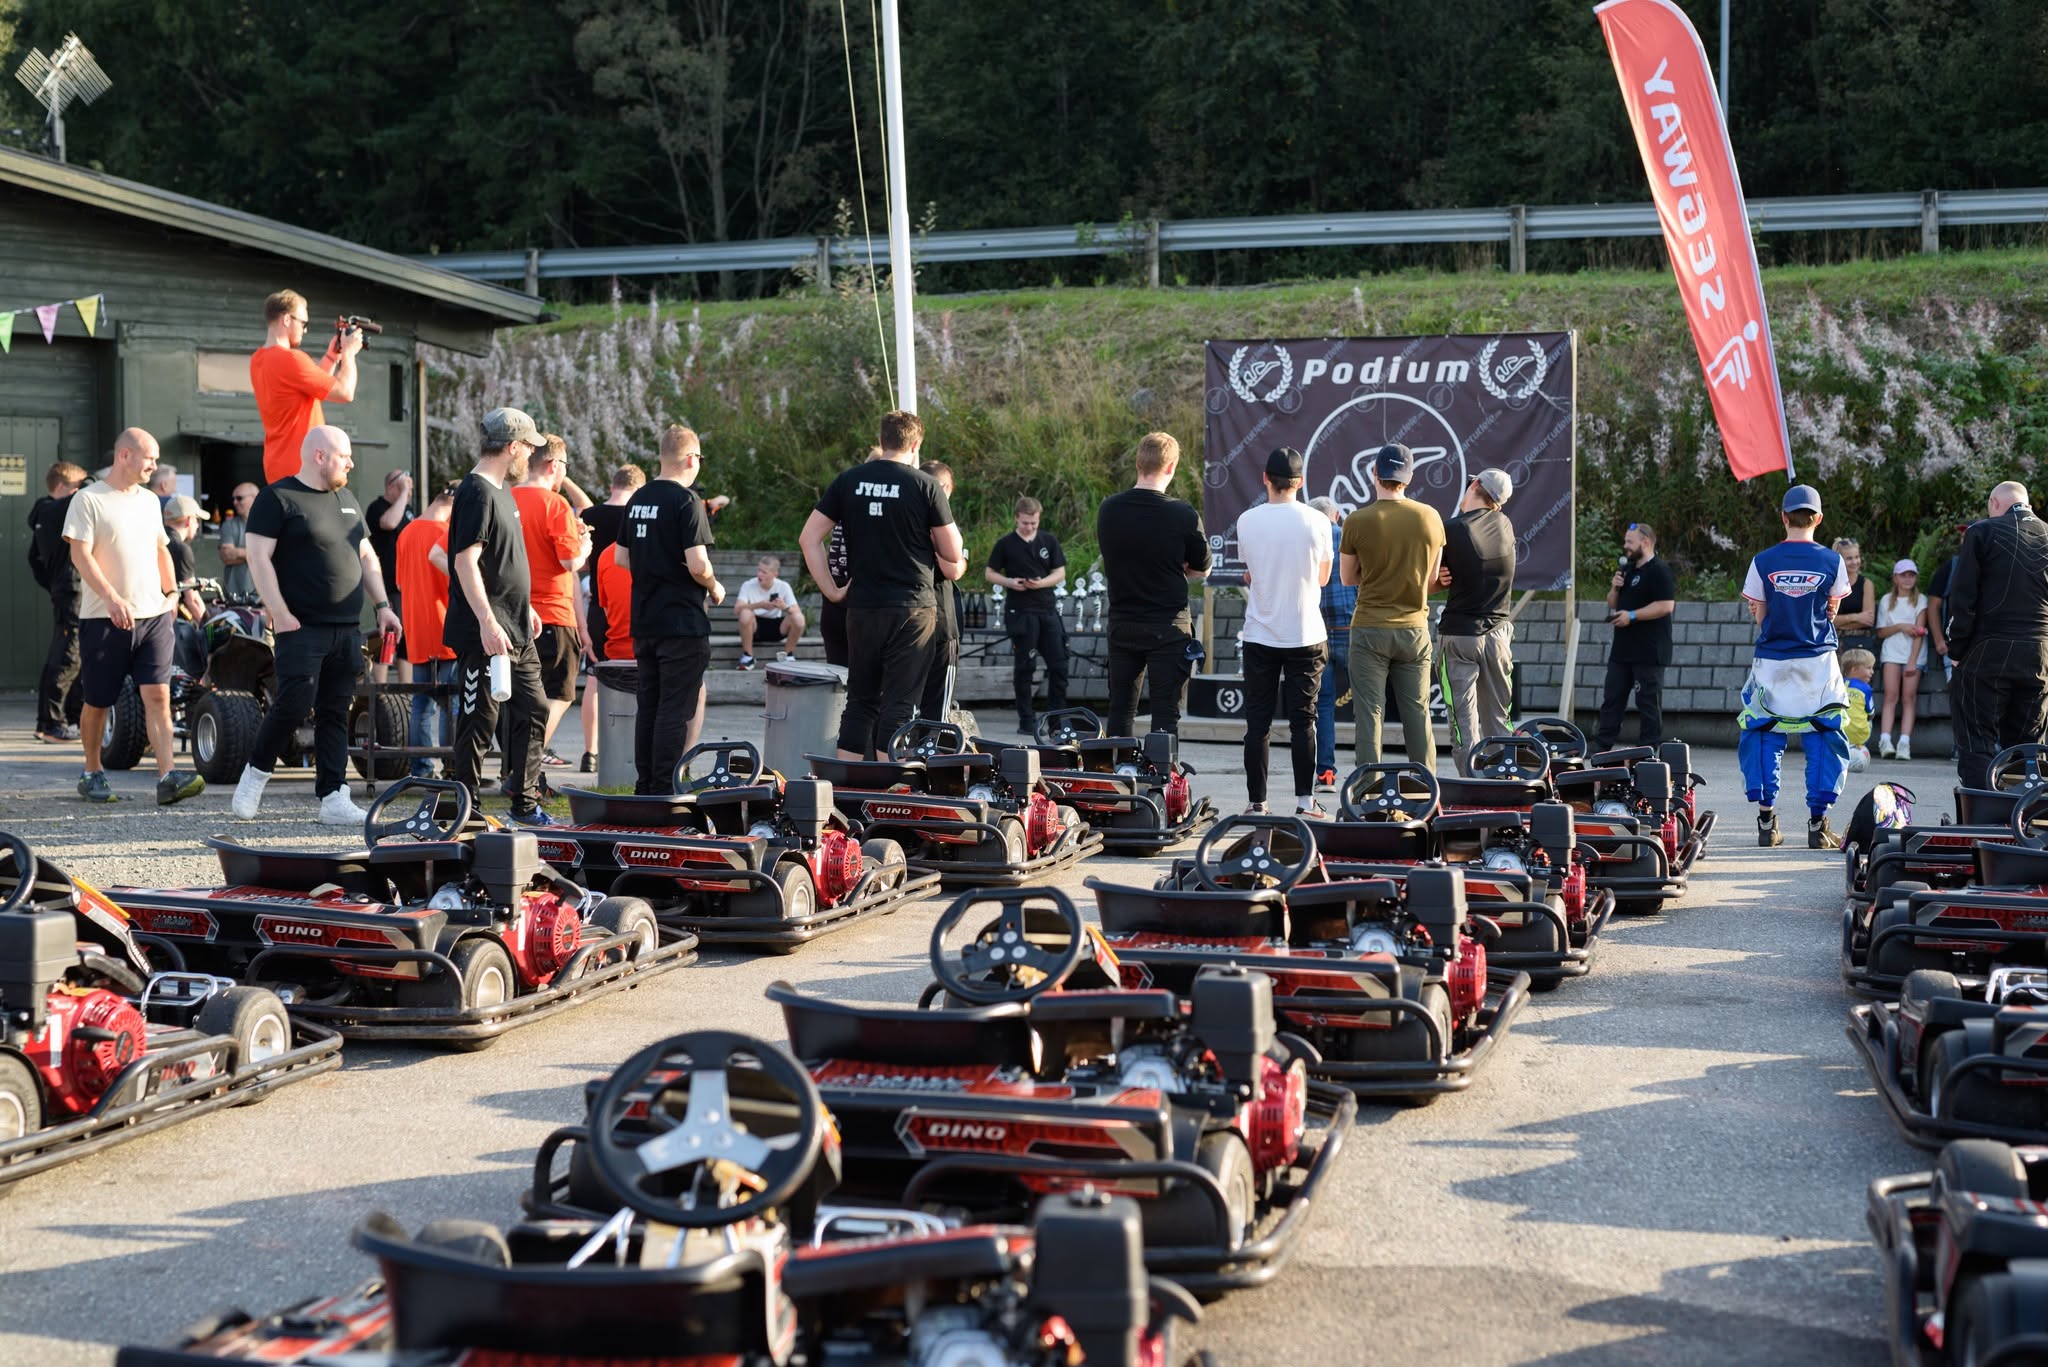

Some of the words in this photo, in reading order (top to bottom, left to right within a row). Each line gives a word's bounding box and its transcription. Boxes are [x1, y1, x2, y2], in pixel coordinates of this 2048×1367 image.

[1302, 356, 1470, 385] Podium
[1776, 575, 1817, 586] ROK
[1224, 691, 1236, 705] 3
[1430, 683, 1447, 709] 2
[876, 806, 912, 816] DINO
[630, 850, 671, 861] DINO
[274, 924, 323, 938] DINO
[928, 1122, 1006, 1141] DINO
